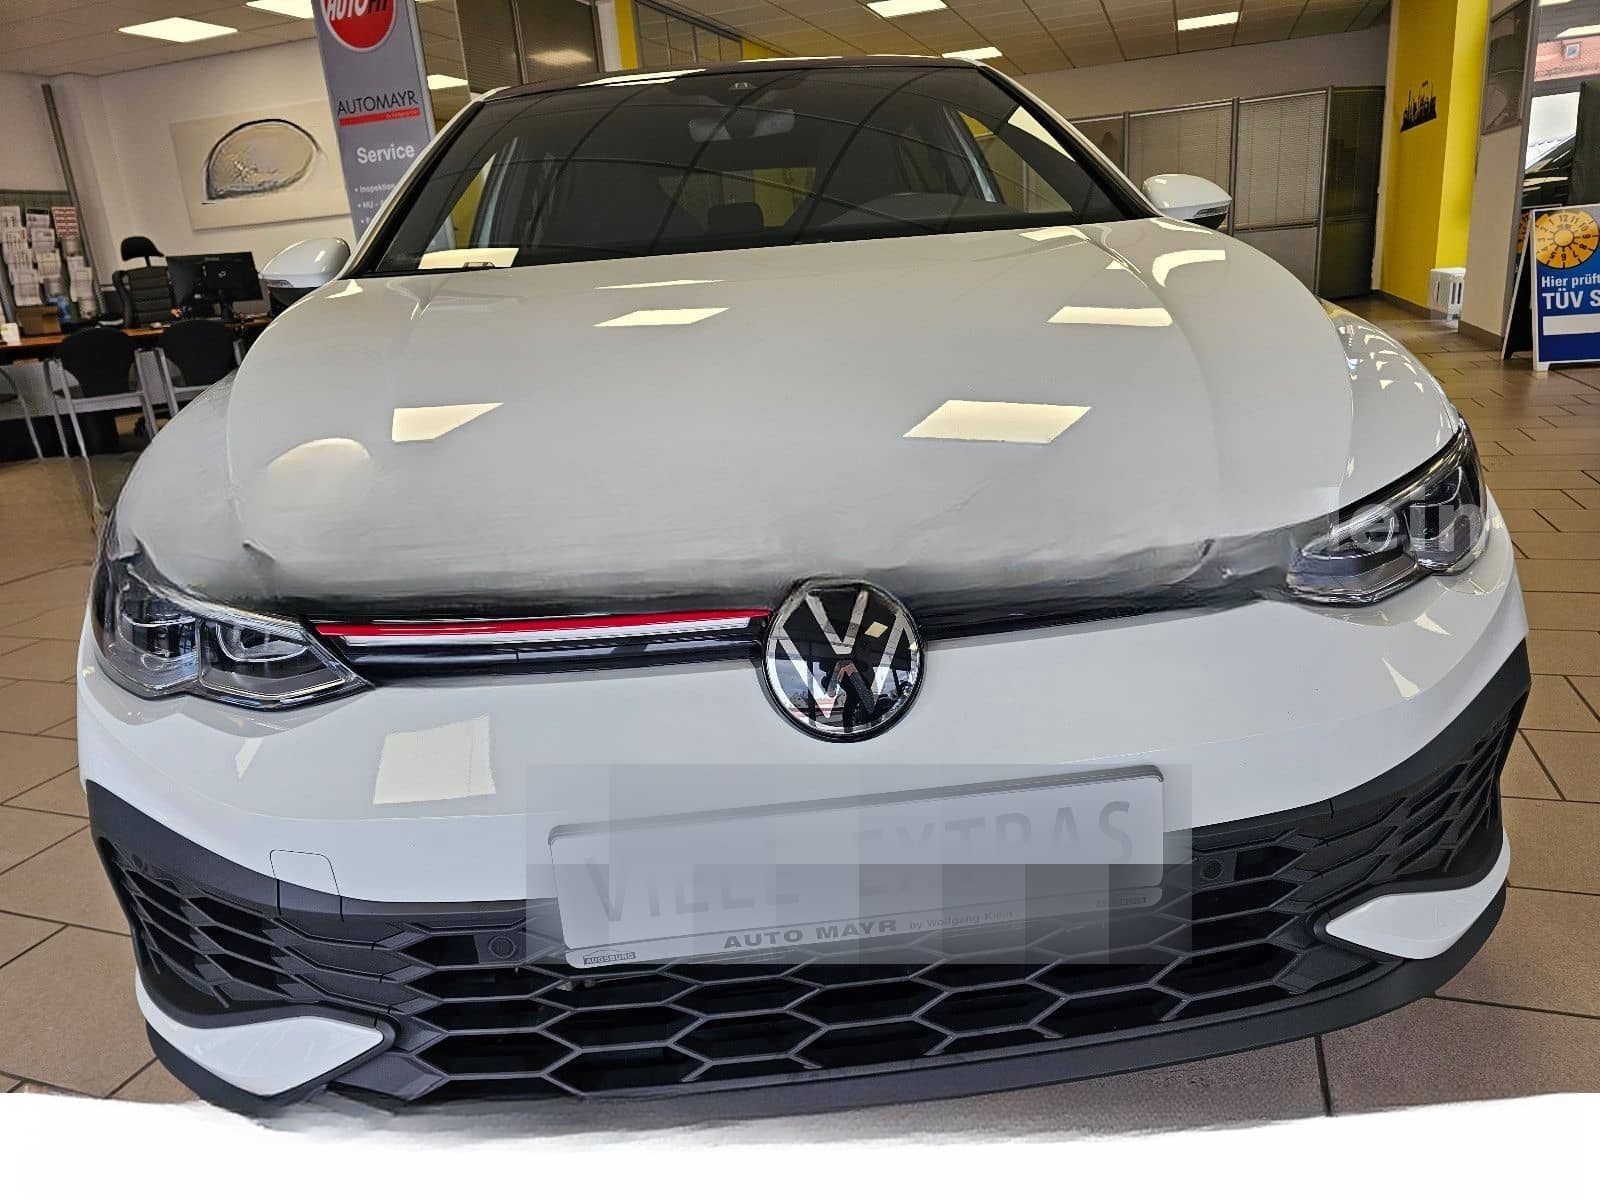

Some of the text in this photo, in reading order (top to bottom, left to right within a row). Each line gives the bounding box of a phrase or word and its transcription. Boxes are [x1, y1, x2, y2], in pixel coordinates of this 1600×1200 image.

[337, 90, 419, 116] AUTOMAYR
[356, 143, 415, 164] Service
[1541, 275, 1568, 288] Hier
[1541, 287, 1584, 310] TÜV
[724, 929, 803, 949] AUTO
[815, 919, 897, 940] MAYR
